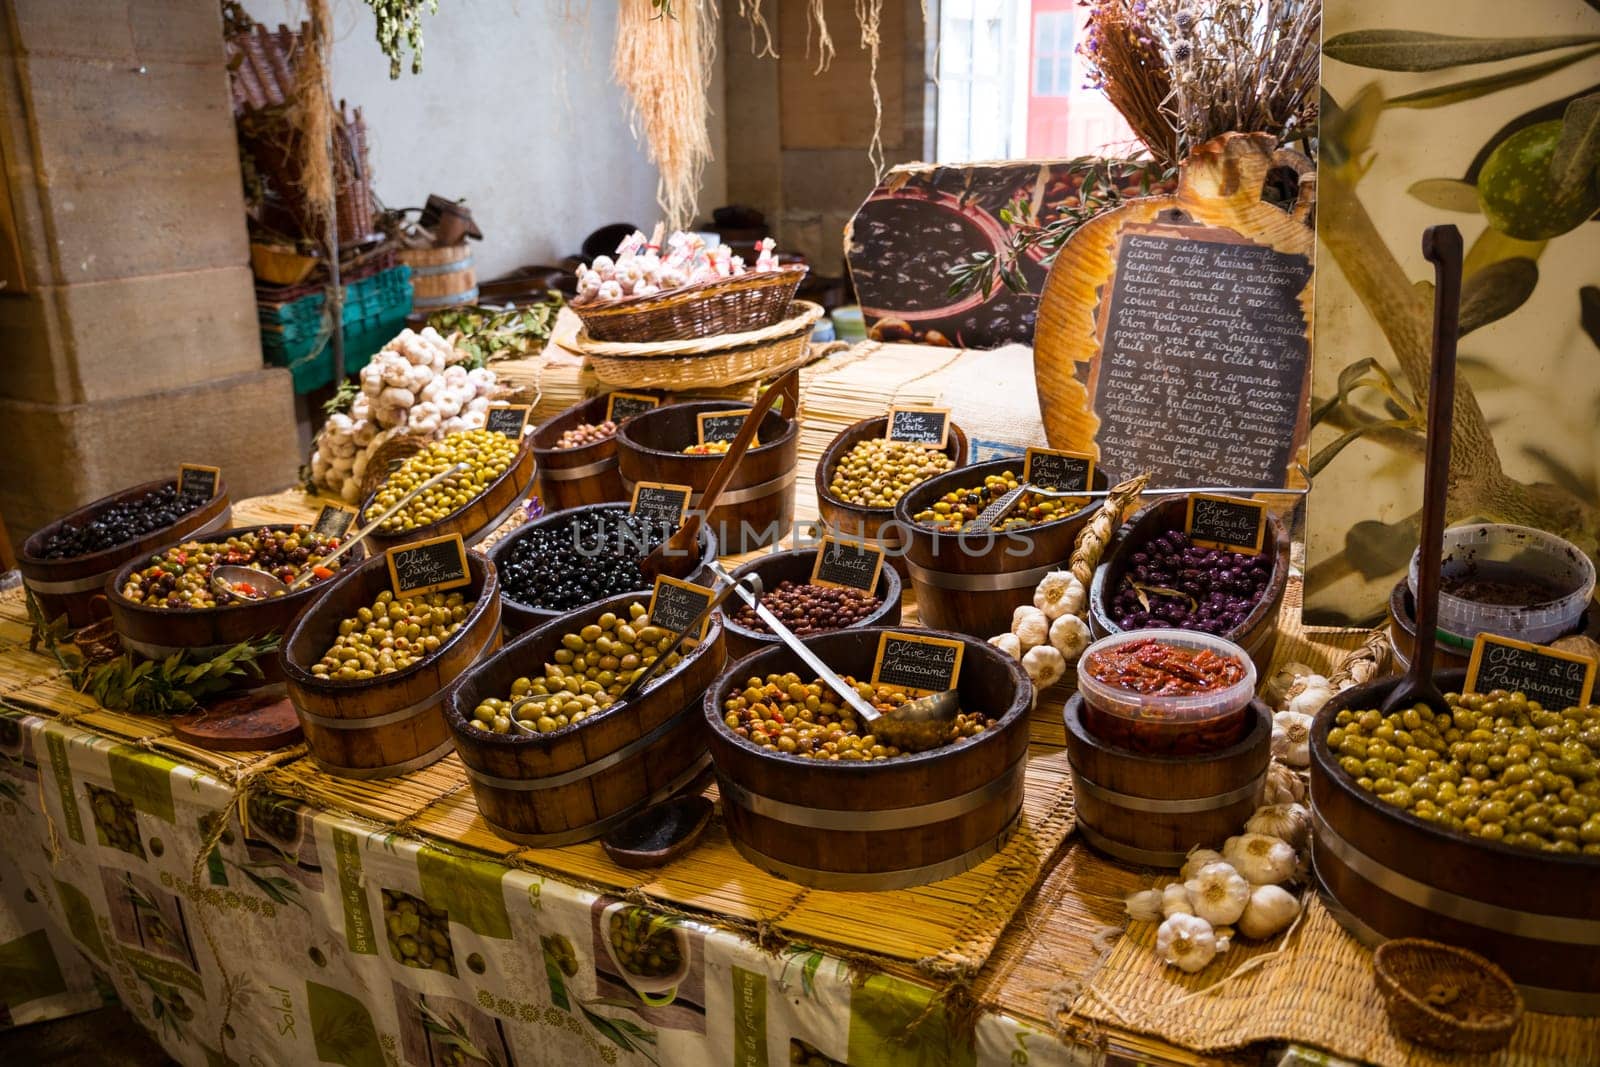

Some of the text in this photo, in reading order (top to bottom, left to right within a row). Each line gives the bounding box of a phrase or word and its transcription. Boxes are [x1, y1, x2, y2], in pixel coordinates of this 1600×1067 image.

[1129, 237, 1168, 250] tomate
[1127, 250, 1162, 261] citron
[1126, 261, 1176, 275] tapenade
[1210, 278, 1224, 291] de
[1124, 283, 1181, 299] tapenade
[1189, 290, 1219, 303] verte
[1228, 292, 1241, 305] et
[1119, 317, 1146, 329] thon
[1113, 328, 1159, 344] poivron
[1164, 334, 1189, 347] vert
[1195, 337, 1206, 349] et
[1212, 341, 1245, 356] rouge
[1117, 340, 1145, 353] huile
[1202, 349, 1217, 362] de
[1110, 368, 1133, 379] aux
[1193, 368, 1219, 380] aux
[1151, 384, 1161, 394] à
[1166, 384, 1179, 397] la
[895, 411, 926, 424] Olive
[1153, 406, 1161, 417] à
[1209, 415, 1218, 425] à
[1221, 414, 1233, 428] la
[1108, 423, 1117, 433] à
[1204, 438, 1221, 450] au
[1104, 446, 1139, 459] noire
[1149, 442, 1166, 453] au
[1224, 453, 1254, 467] verte
[1032, 455, 1060, 469] Olive
[1174, 469, 1191, 480] du
[1197, 501, 1235, 516] Olive
[396, 550, 431, 569] Olive
[658, 584, 690, 605] Olive
[887, 640, 955, 664] Olive à la
[882, 656, 950, 678] Marocaine
[1489, 647, 1582, 682] Olive à la
[1483, 665, 1580, 701] Paysanne
[268, 985, 297, 1040] Soleil
